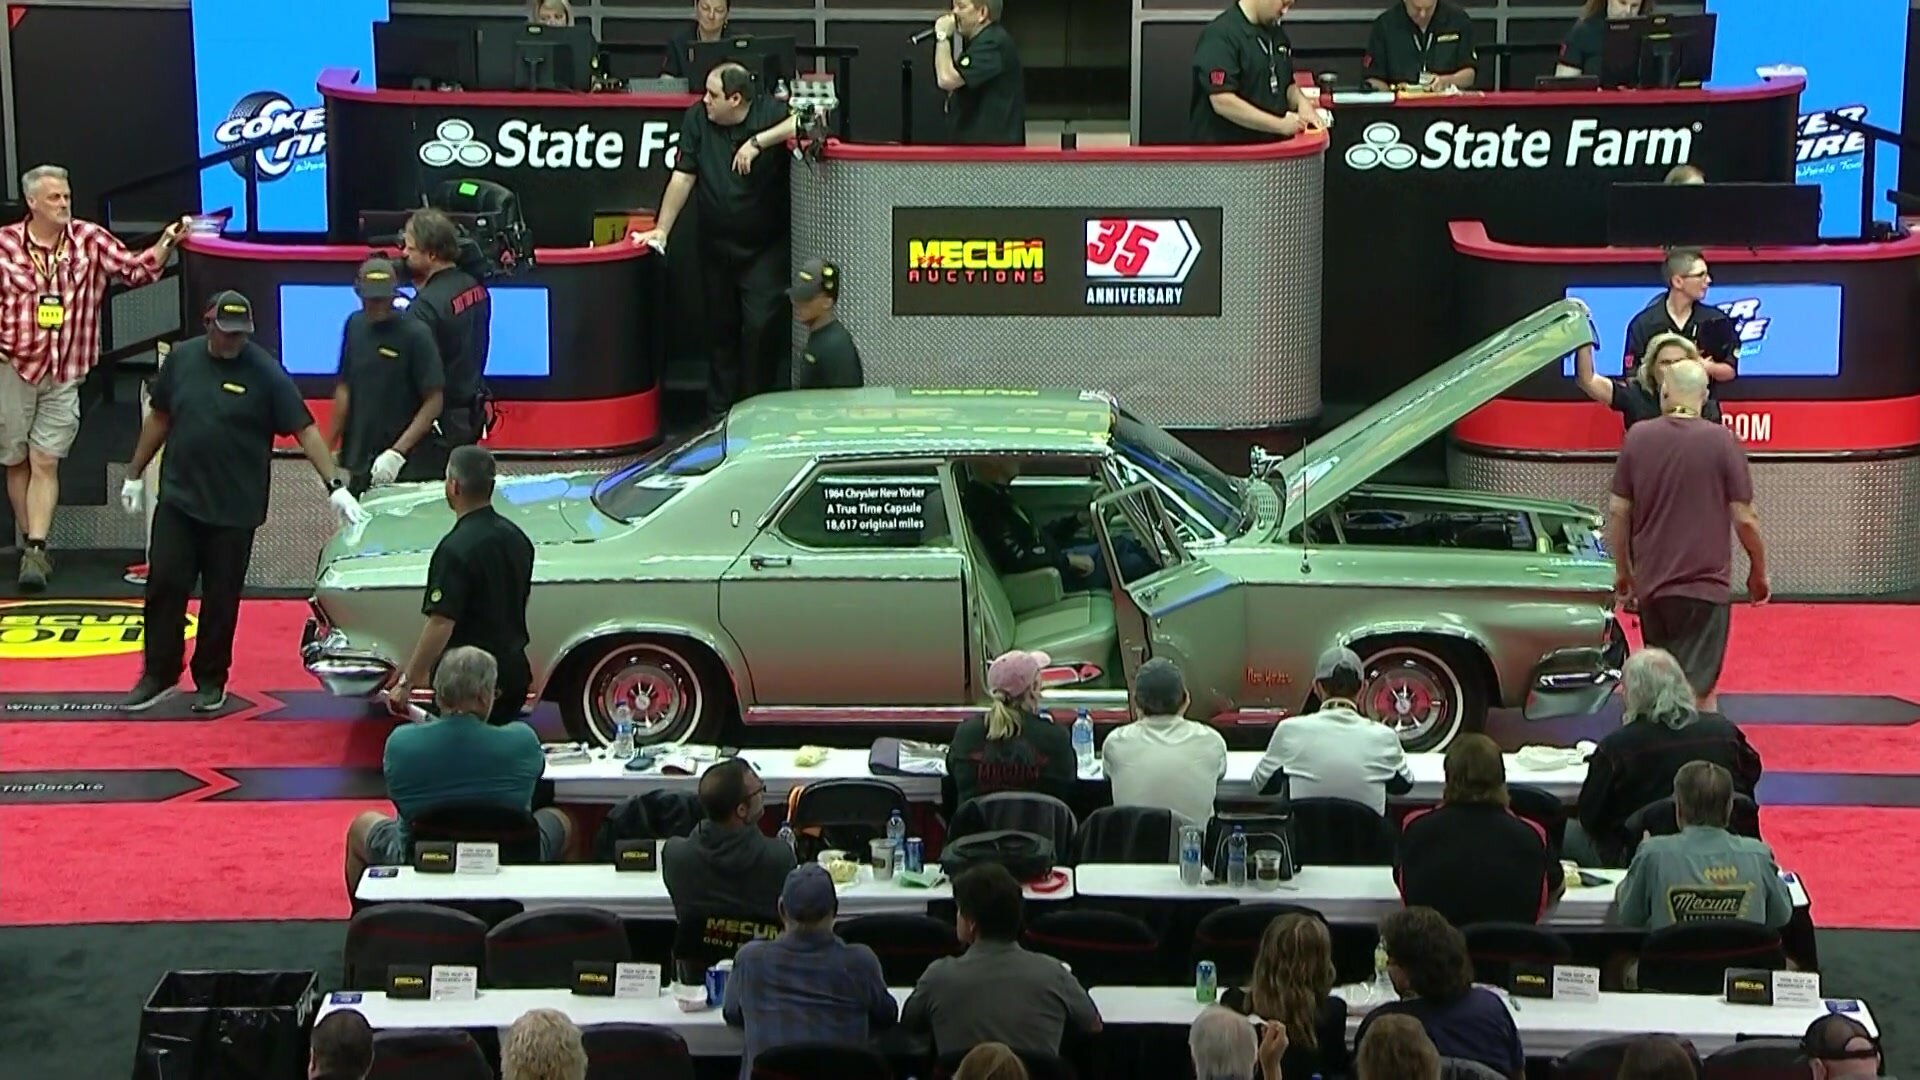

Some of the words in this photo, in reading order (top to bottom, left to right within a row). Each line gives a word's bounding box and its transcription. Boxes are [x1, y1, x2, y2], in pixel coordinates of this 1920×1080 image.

[495, 119, 624, 169] State
[1420, 121, 1551, 169] State
[909, 240, 1043, 269] MECUM
[1088, 219, 1159, 277] 35
[909, 270, 1045, 282] AUCTIONS
[1086, 288, 1183, 304] ANNIVERSARY
[845, 487, 879, 501] Chrysler
[880, 488, 898, 498] New
[899, 487, 925, 498] Yorker
[827, 503, 835, 514] A
[836, 503, 857, 514] True
[859, 503, 882, 514] Time
[884, 502, 922, 516] Capsule
[826, 519, 857, 531] 18,617
[859, 518, 897, 532] original
[899, 517, 924, 528] miles
[1673, 892, 1738, 911] Mecum
